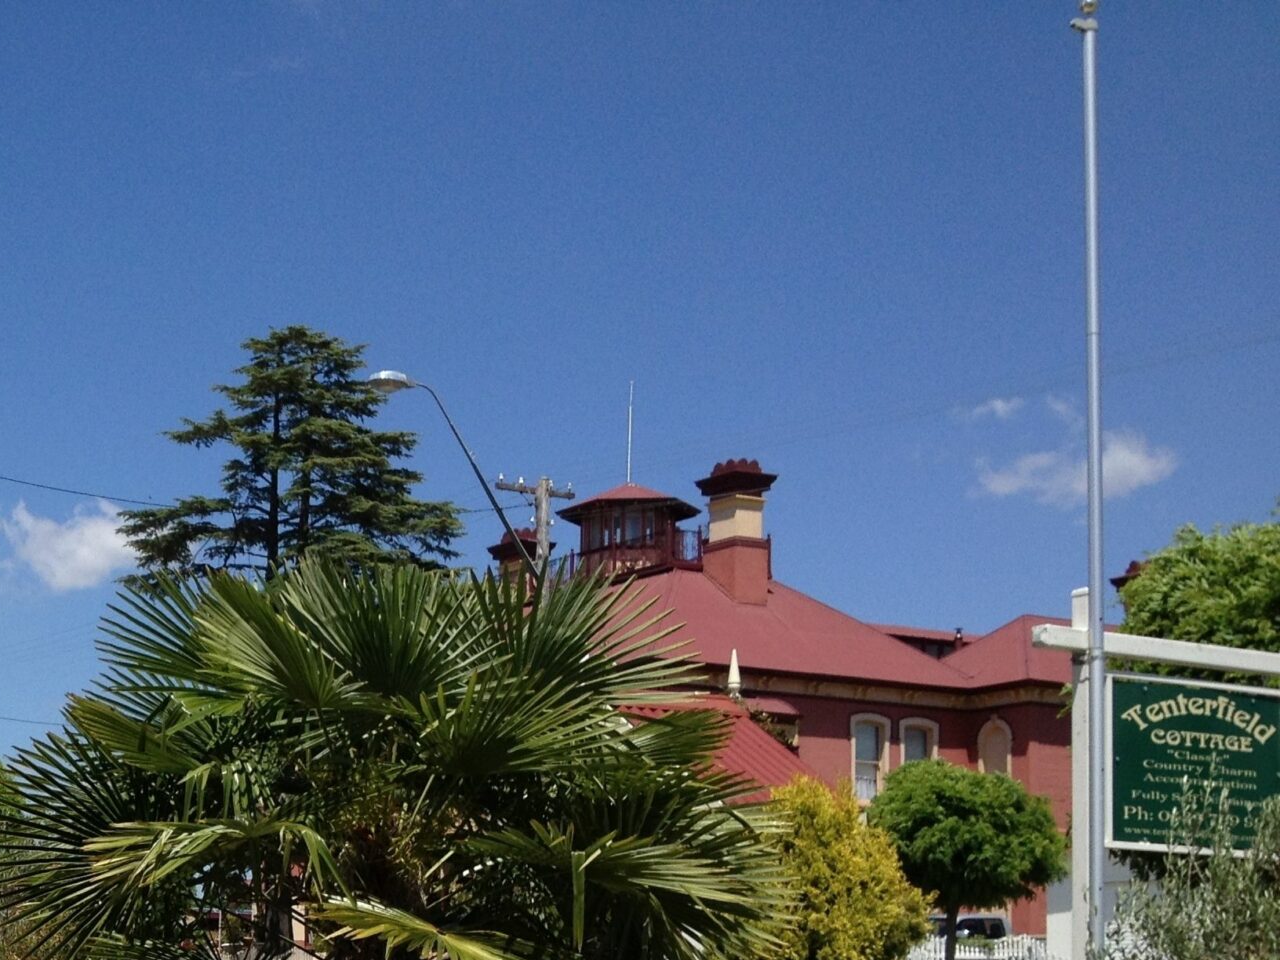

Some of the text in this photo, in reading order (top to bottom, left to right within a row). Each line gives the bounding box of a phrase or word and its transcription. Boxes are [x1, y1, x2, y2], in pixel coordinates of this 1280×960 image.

[1121, 693, 1277, 745] Tenterfield
[1150, 728, 1253, 753] COTTAGE
[1143, 759, 1204, 775] Country
[1131, 789, 1168, 804] Fully
[1123, 805, 1154, 821] Ph:
